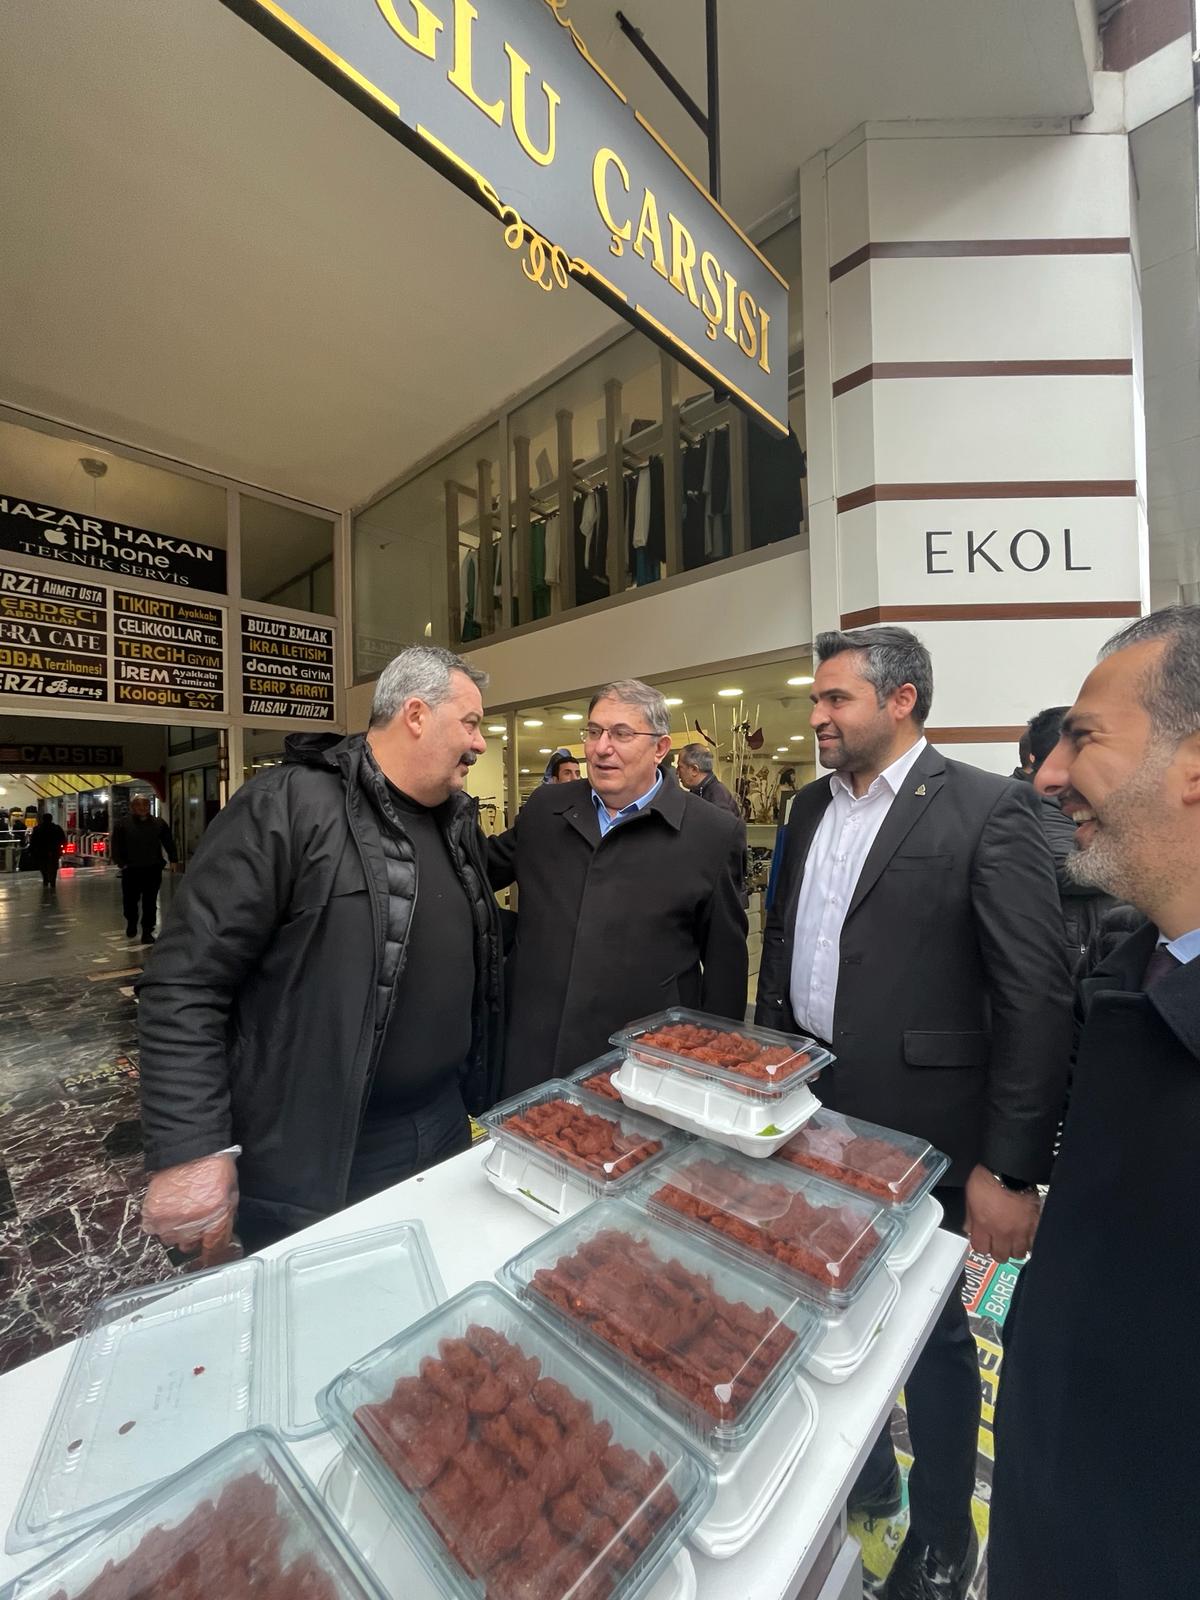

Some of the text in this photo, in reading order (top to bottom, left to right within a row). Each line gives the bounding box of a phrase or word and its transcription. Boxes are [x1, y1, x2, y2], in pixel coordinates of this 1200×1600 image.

[592, 147, 771, 375] ÇARŞISI
[74, 532, 170, 569] iPhone
[114, 526, 213, 562] HAKAN
[926, 529, 1092, 574] EKOL
[42, 580, 78, 598] AHMET
[79, 587, 103, 603] USTA
[48, 630, 101, 650] CAFE
[247, 619, 328, 644] BULUT EMLAK
[44, 656, 103, 675] Terzihanesi
[172, 668, 218, 680] Ayakkabı
[246, 658, 298, 677] damat
[175, 677, 216, 689] Tamiratı
